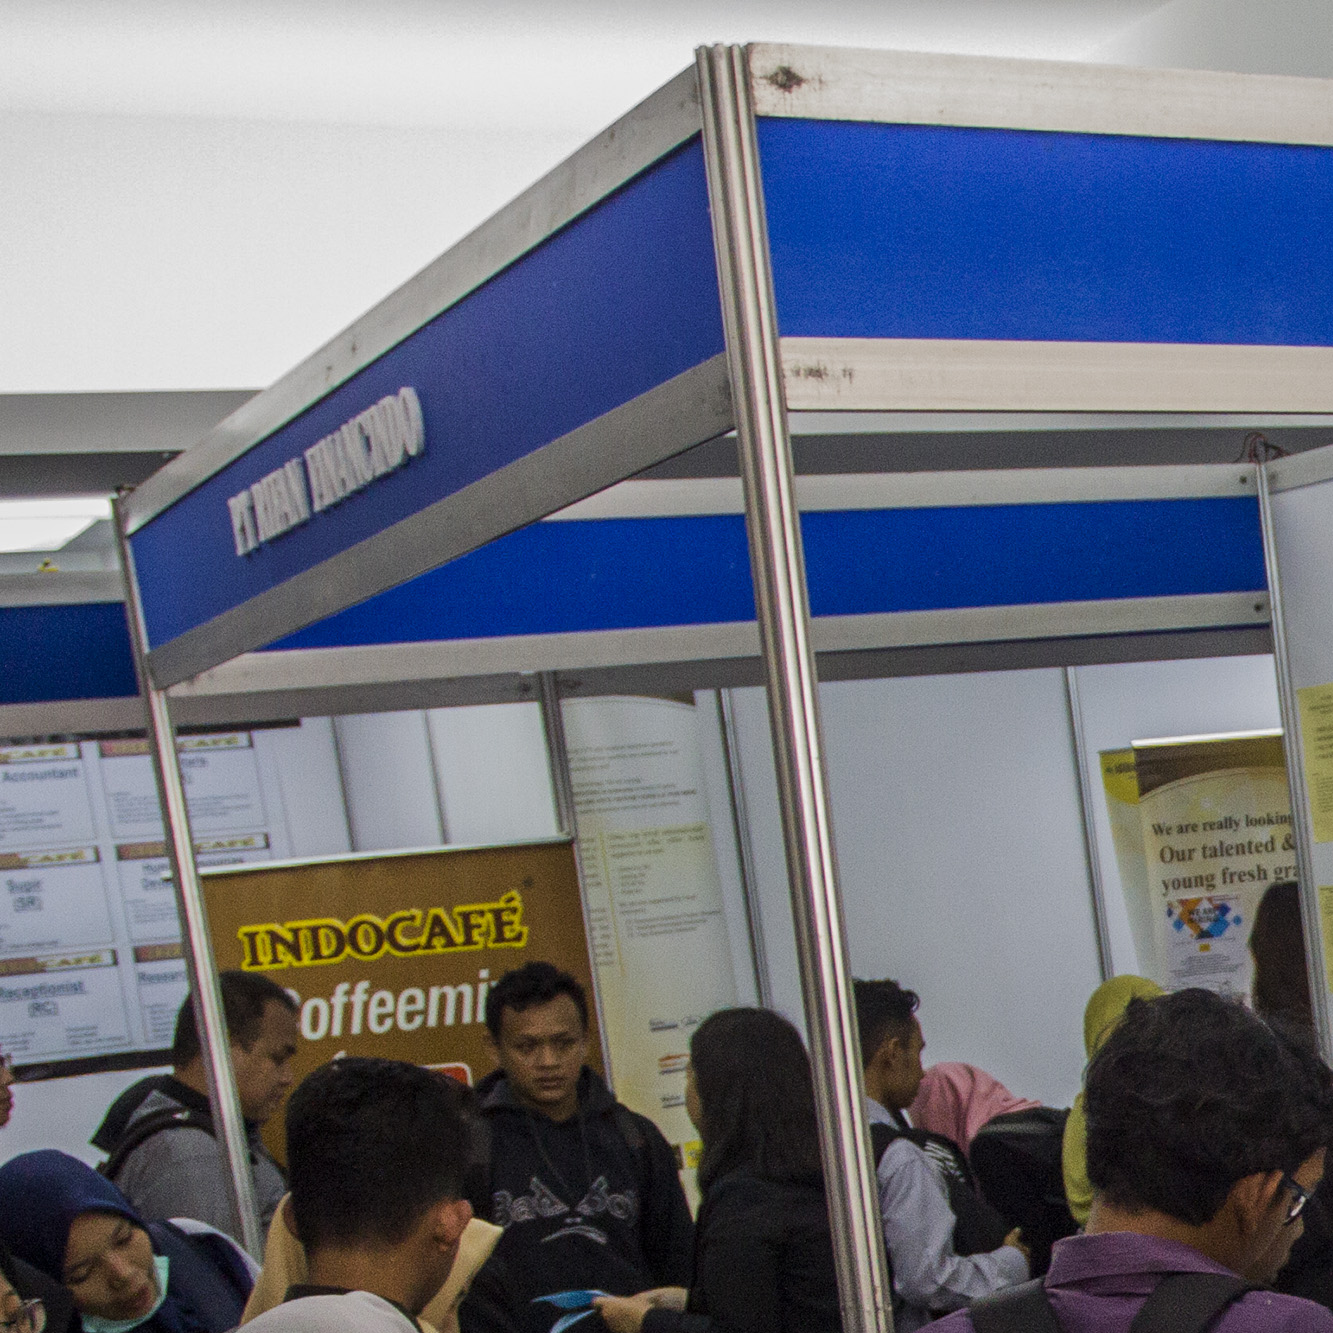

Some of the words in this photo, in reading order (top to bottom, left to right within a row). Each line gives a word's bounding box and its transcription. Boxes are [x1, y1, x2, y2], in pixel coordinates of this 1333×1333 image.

[1152, 822, 1173, 836] We
[1177, 823, 1198, 834] are
[1203, 816, 1241, 834] really
[1245, 812, 1293, 827] lookin
[1159, 845, 1196, 864] Our
[1202, 836, 1275, 861] talented
[1281, 833, 1296, 851] &
[1161, 873, 1217, 896] young
[1222, 864, 1268, 884] fresh
[237, 889, 530, 971] INDOCAFÉ
[286, 968, 498, 1040] offeemi
